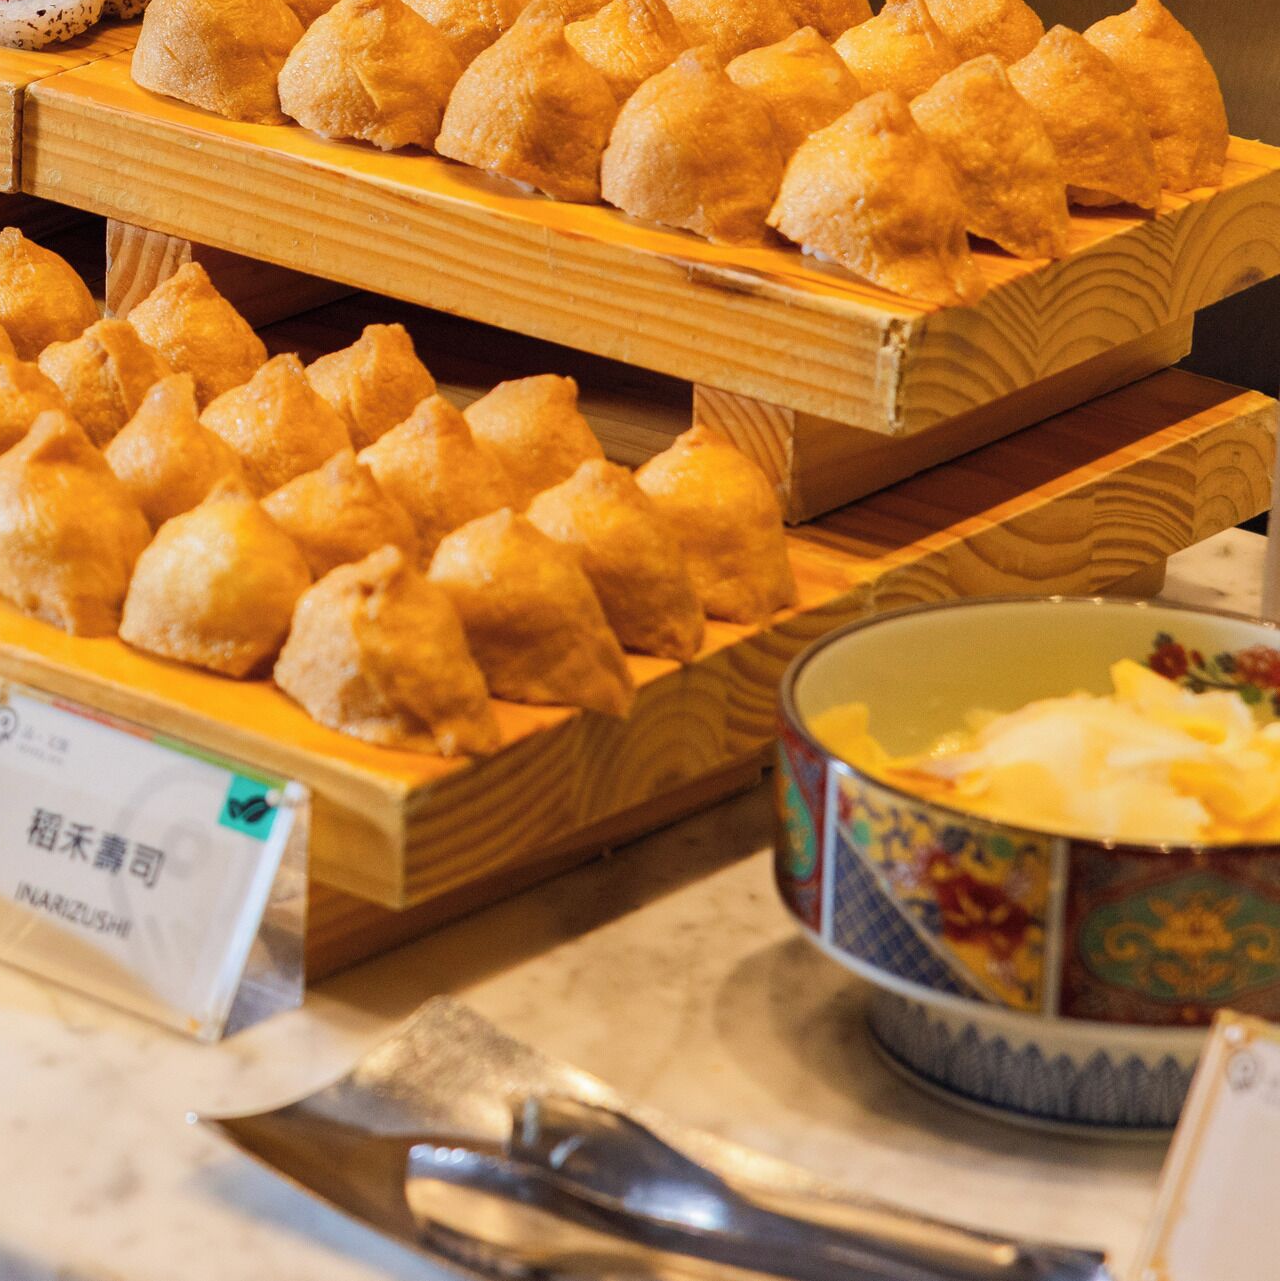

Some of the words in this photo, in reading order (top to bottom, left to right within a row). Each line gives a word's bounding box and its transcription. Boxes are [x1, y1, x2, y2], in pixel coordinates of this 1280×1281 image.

[27, 807, 166, 889] 稻禾壽司
[13, 880, 132, 939] INARIZUSHI
